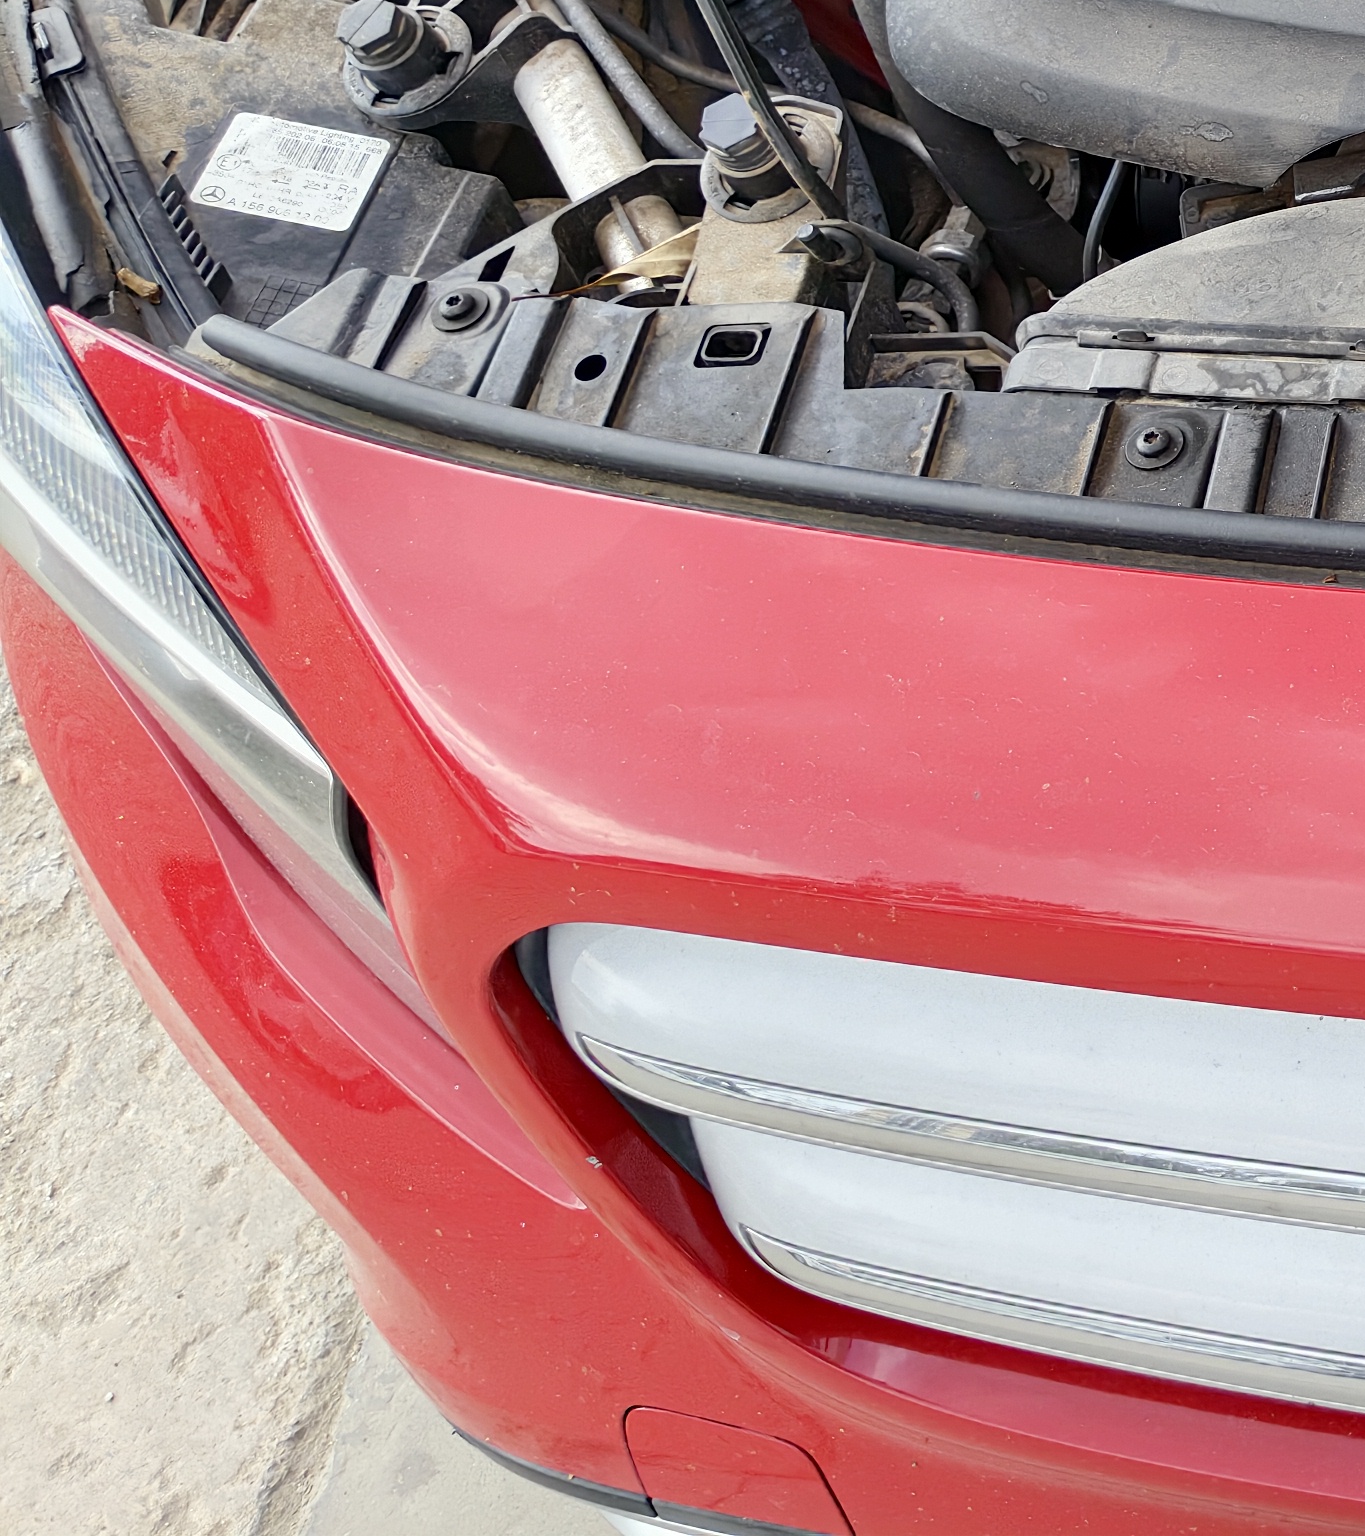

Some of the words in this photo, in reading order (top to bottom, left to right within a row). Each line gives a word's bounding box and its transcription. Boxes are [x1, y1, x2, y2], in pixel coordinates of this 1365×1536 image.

[320, 129, 355, 143] Lighting
[226, 197, 237, 206] A
[241, 201, 265, 212] 156
